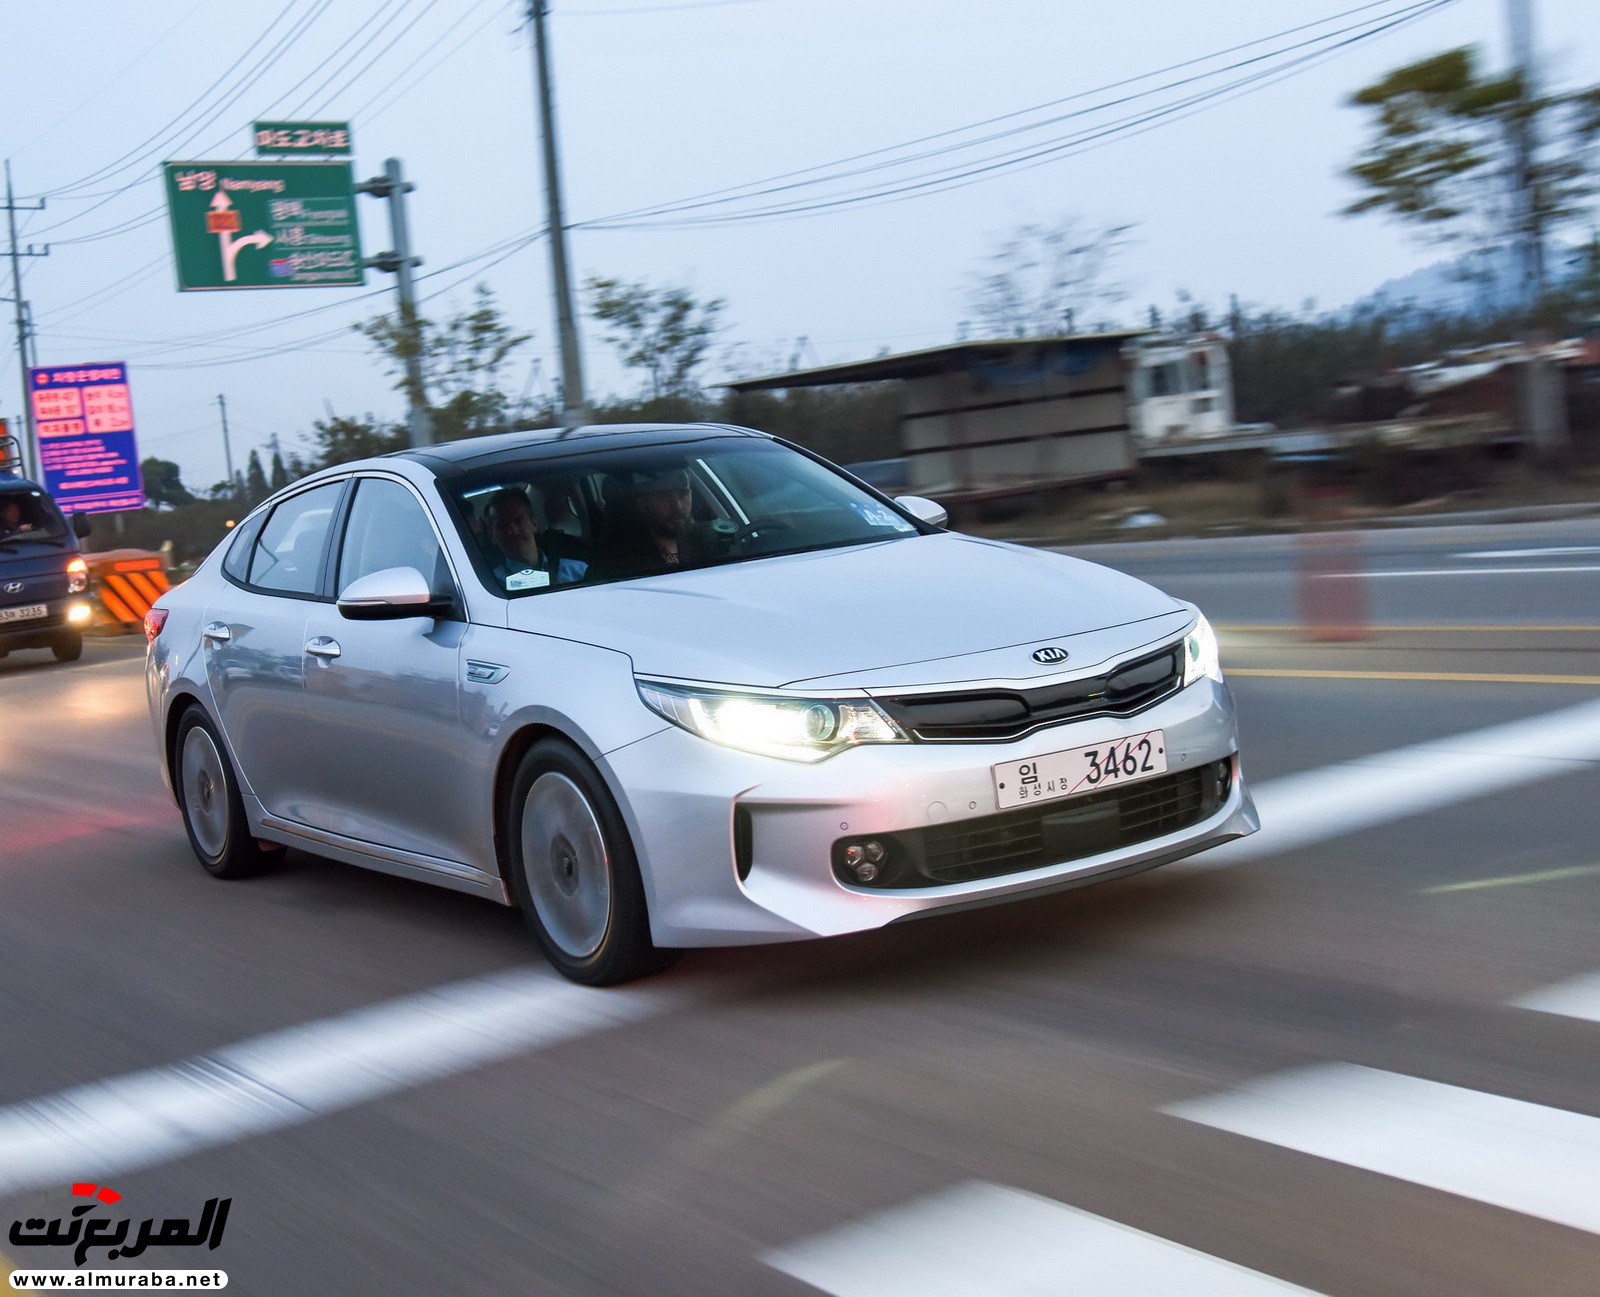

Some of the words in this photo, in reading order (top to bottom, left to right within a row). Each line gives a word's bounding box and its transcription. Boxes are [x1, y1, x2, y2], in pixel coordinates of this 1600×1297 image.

[19, 606, 43, 618] 3235
[1035, 648, 1067, 662] KIA
[1018, 762, 1039, 785] 임
[1084, 738, 1154, 785] 3462
